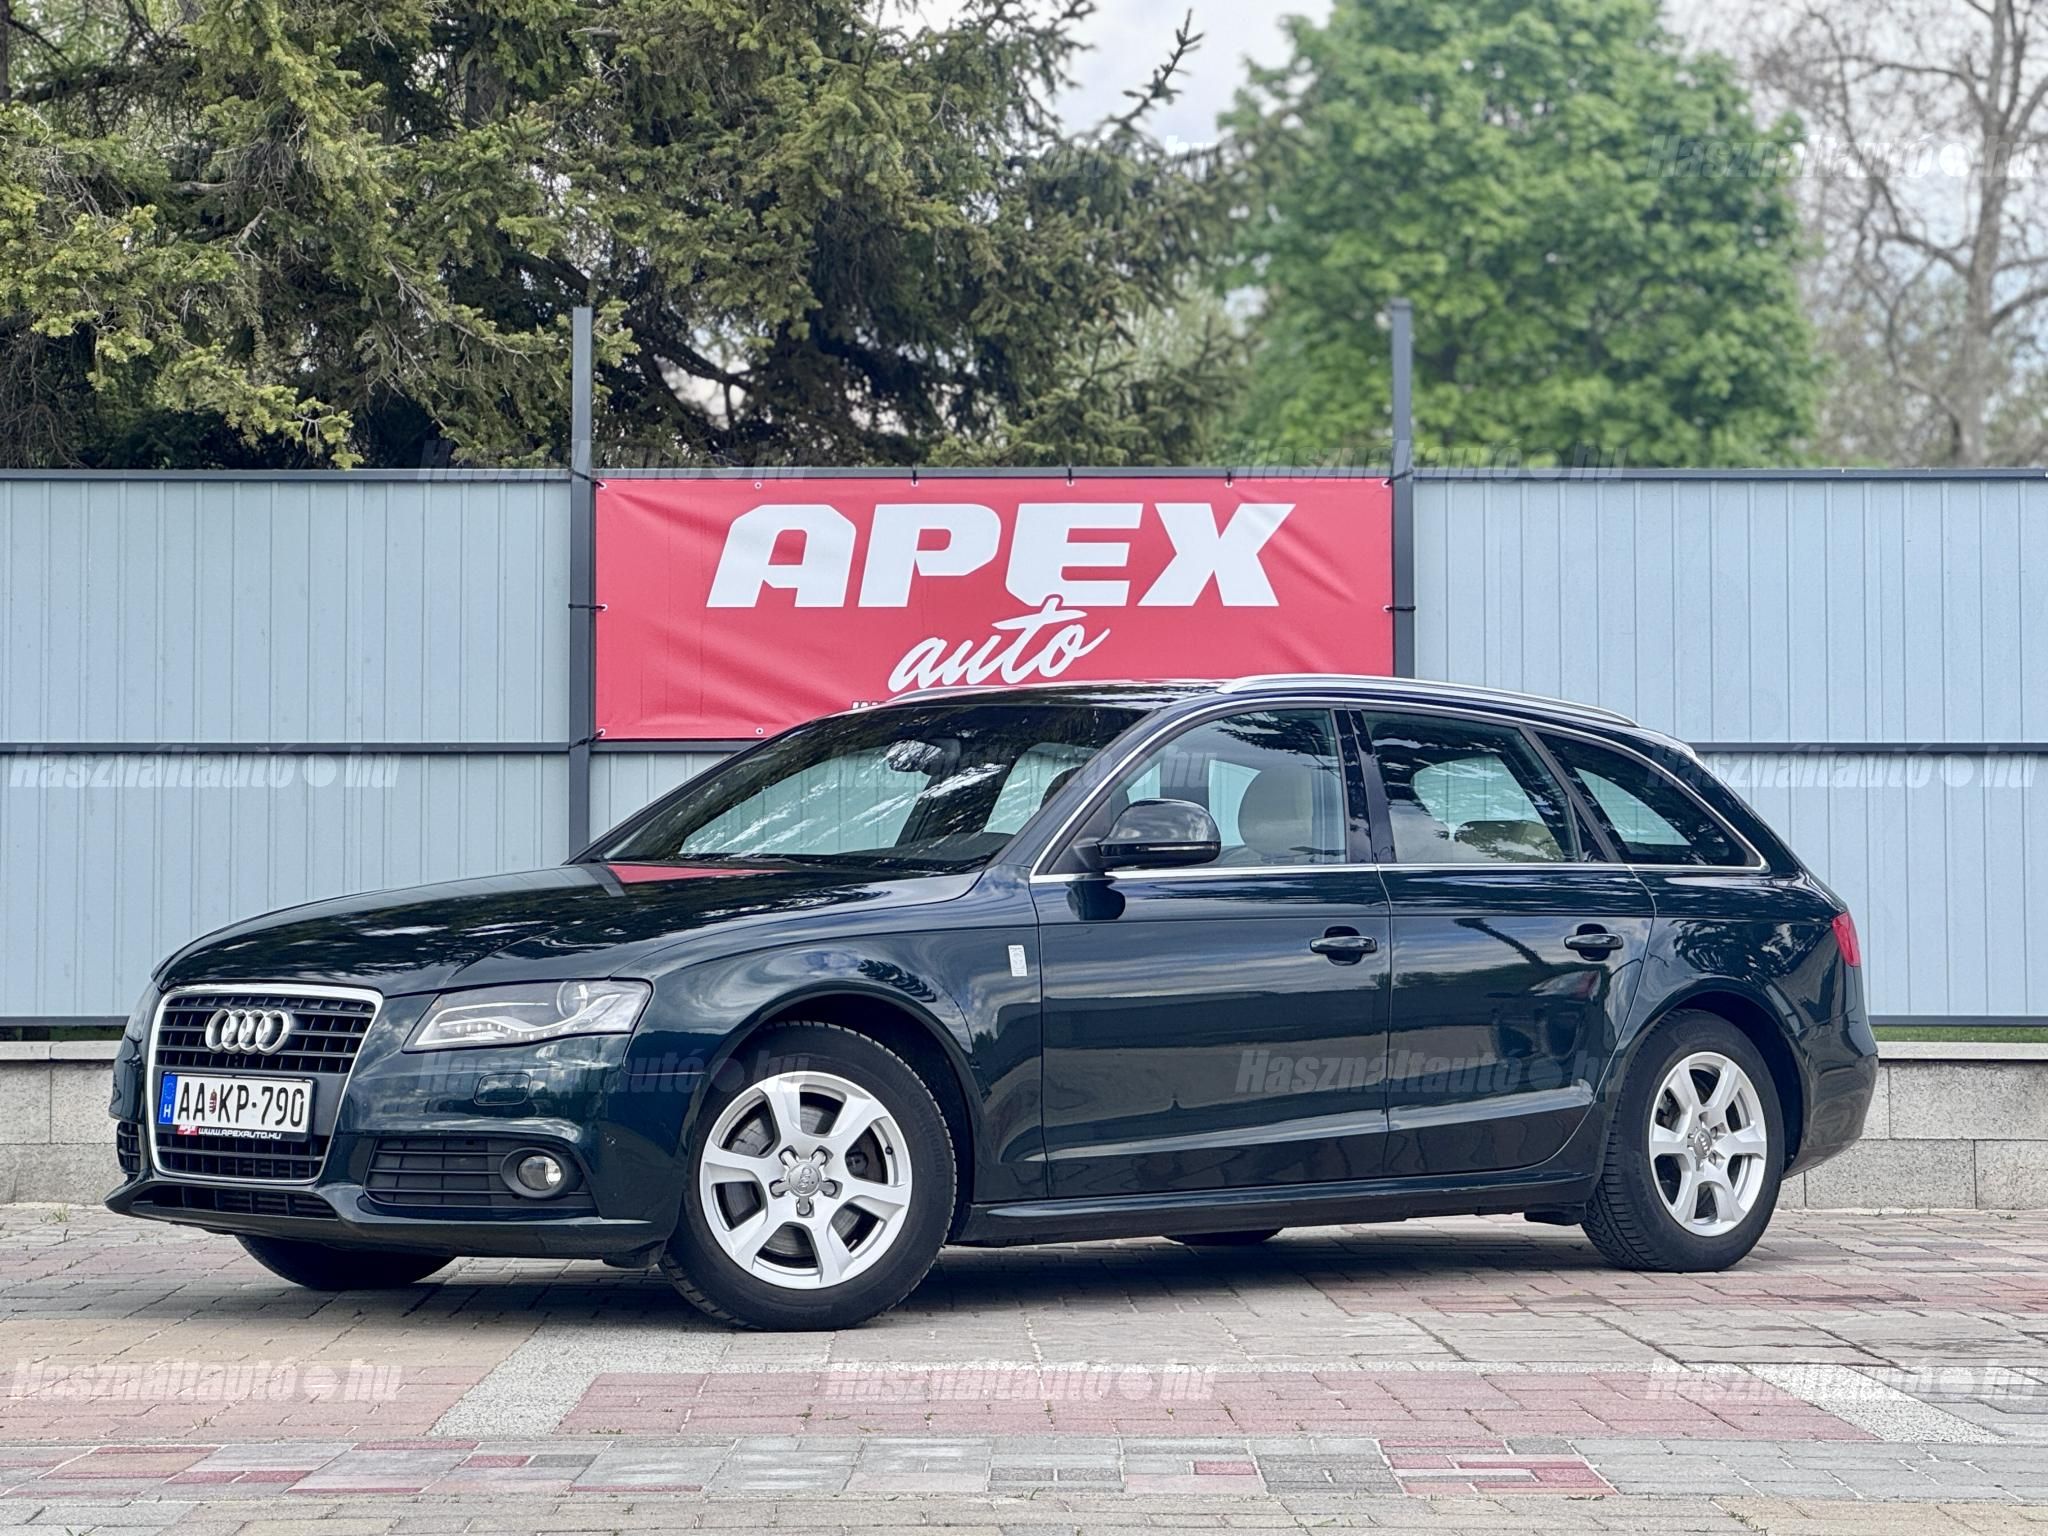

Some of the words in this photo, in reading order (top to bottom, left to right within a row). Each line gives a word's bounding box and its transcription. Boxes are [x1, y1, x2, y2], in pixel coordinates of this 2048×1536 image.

[706, 503, 1296, 608] APEX
[888, 596, 1110, 692] auto
[163, 1104, 171, 1118] H
